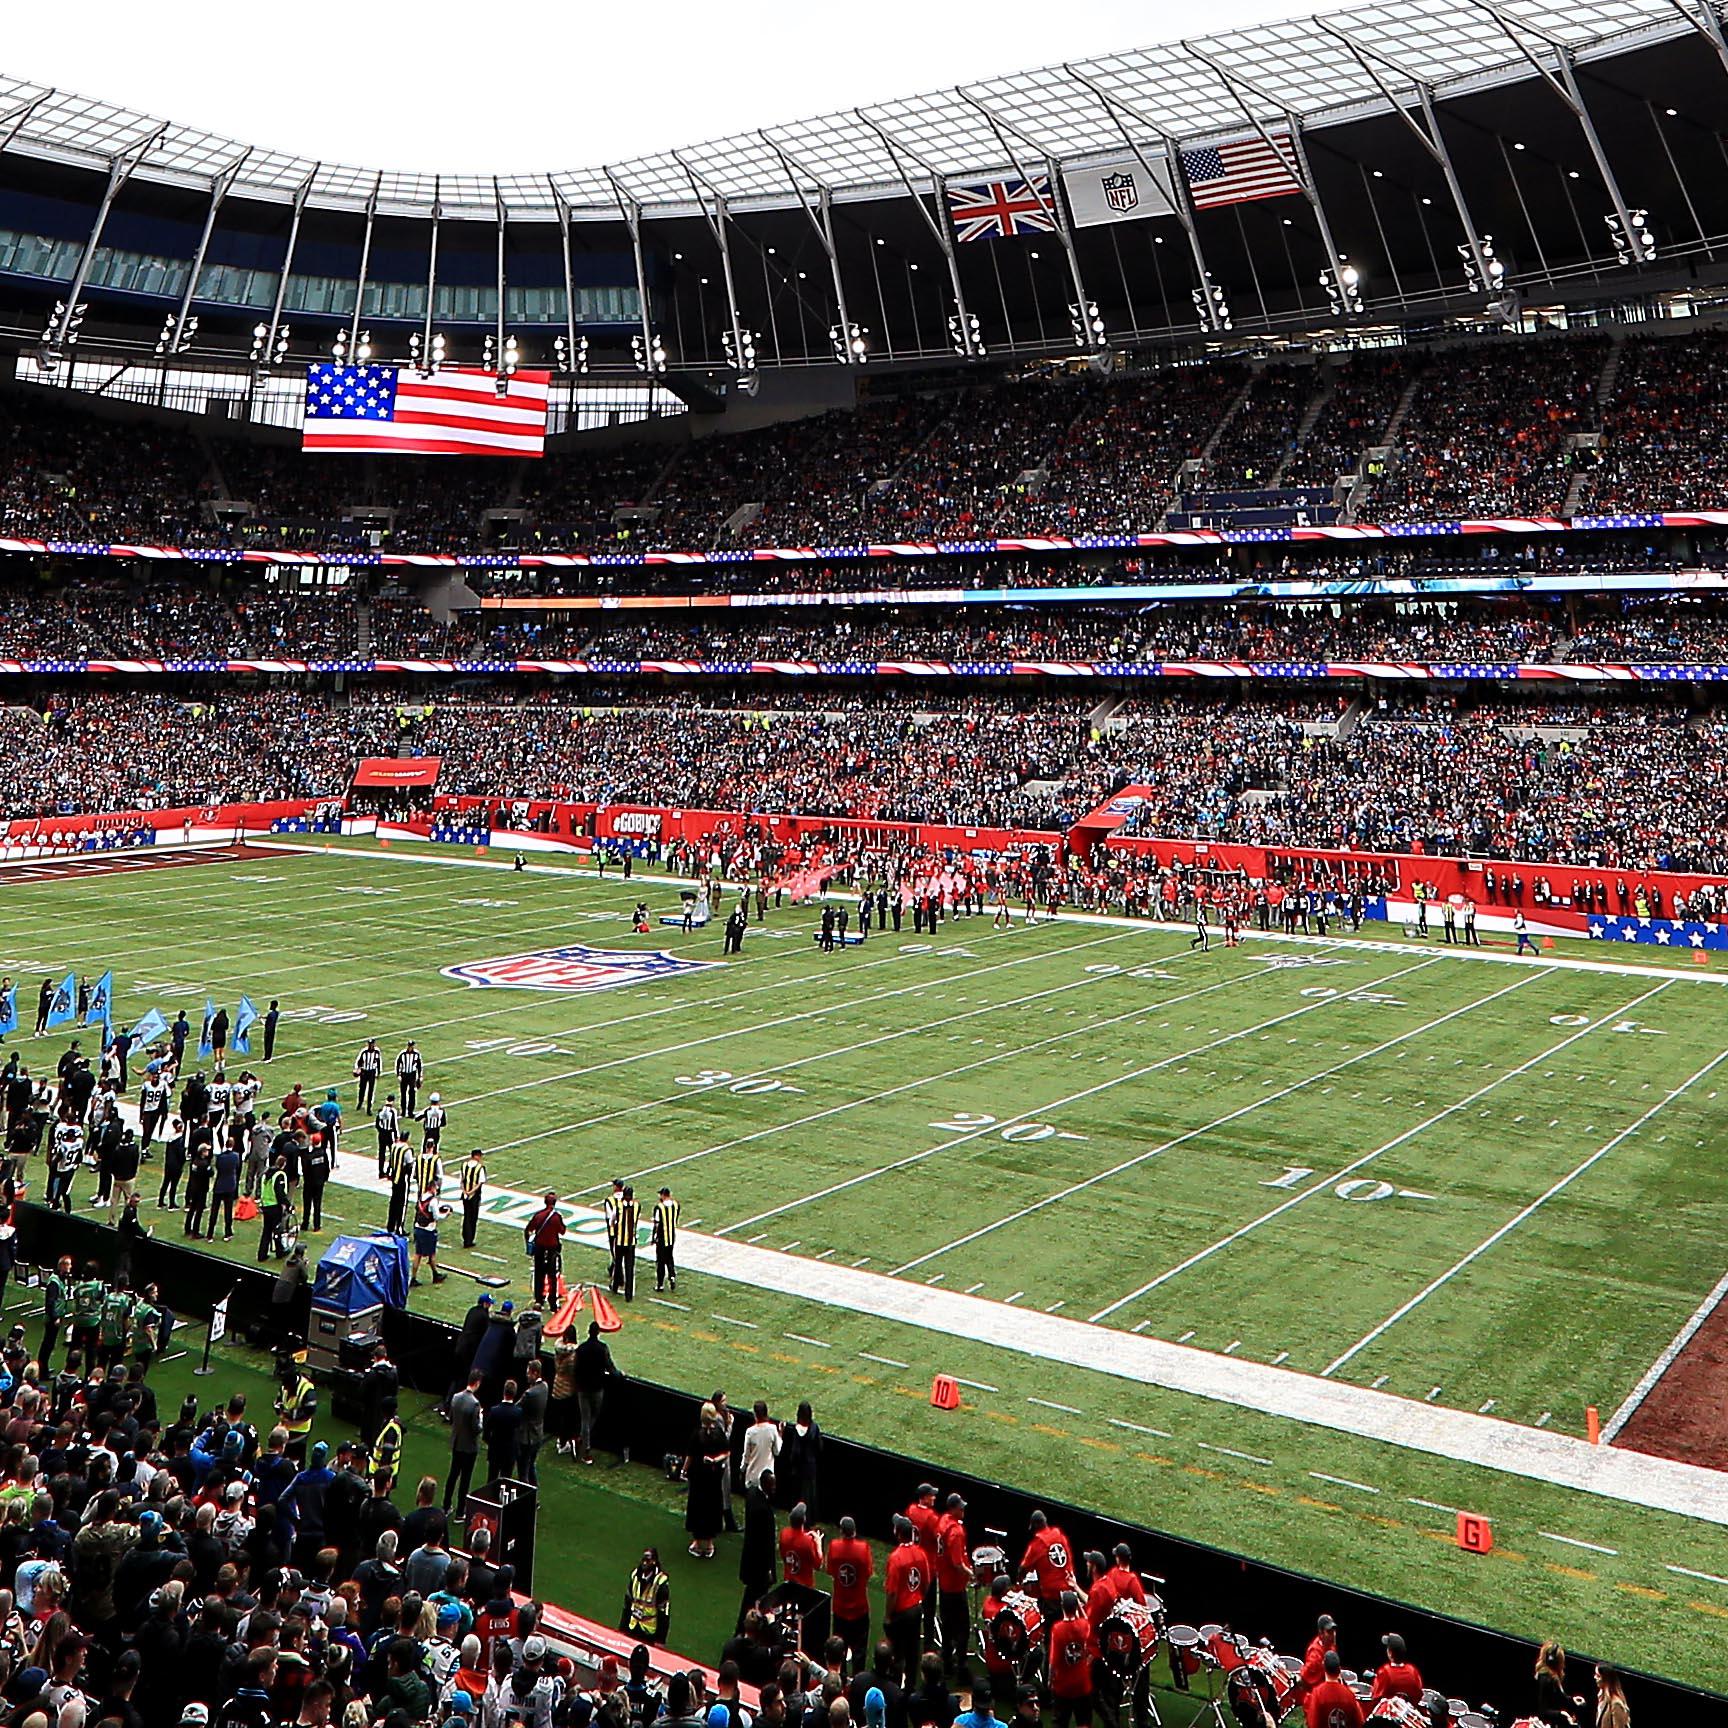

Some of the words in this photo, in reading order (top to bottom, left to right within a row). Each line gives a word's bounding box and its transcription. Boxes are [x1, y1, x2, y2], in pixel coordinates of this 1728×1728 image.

[1108, 188, 1136, 209] NFL
[469, 958, 627, 986] NFL
[279, 1005, 369, 1024] 50
[464, 1037, 558, 1056] 40
[674, 1069, 782, 1095] 30
[146, 1090, 161, 1103] 98
[928, 1112, 1057, 1143] 20
[1258, 1165, 1396, 1202] 10
[936, 1378, 950, 1403] 10
[1464, 1519, 1481, 1549] G
